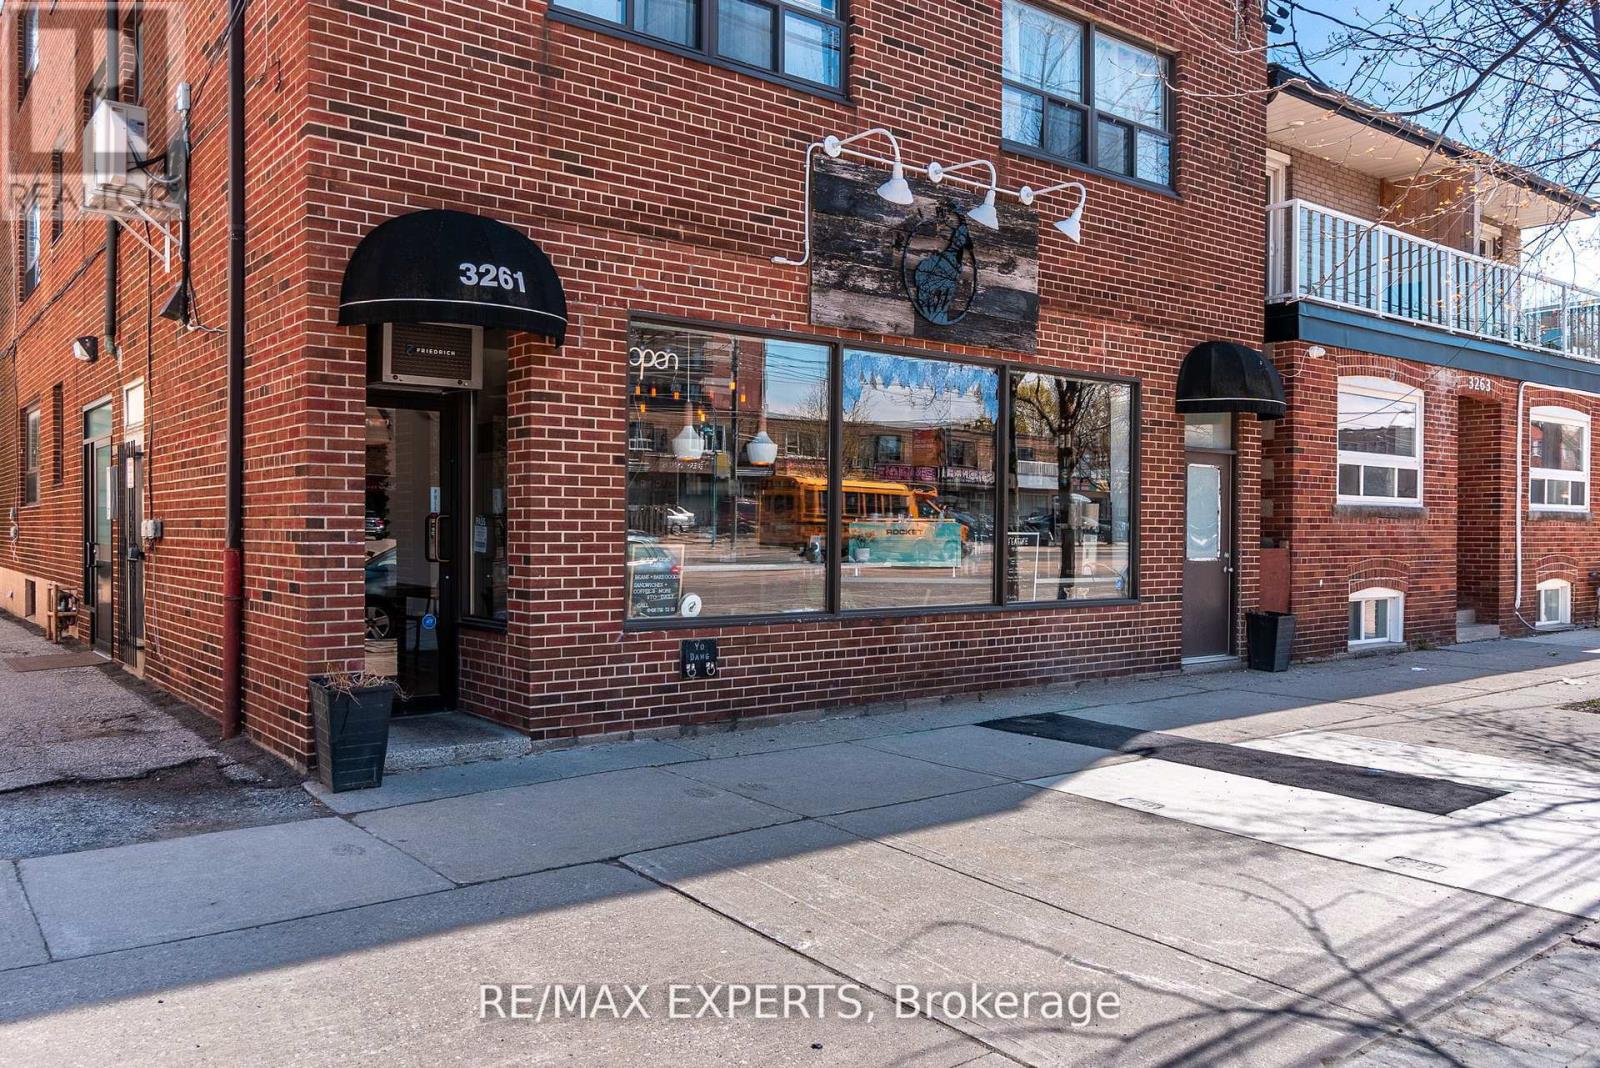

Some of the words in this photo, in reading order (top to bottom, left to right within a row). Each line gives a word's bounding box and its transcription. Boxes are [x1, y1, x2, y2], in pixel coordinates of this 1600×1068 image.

[459, 263, 526, 293] 3261
[416, 347, 456, 356] FRIEDRICH
[629, 347, 679, 380] open
[1468, 376, 1491, 391] 3263
